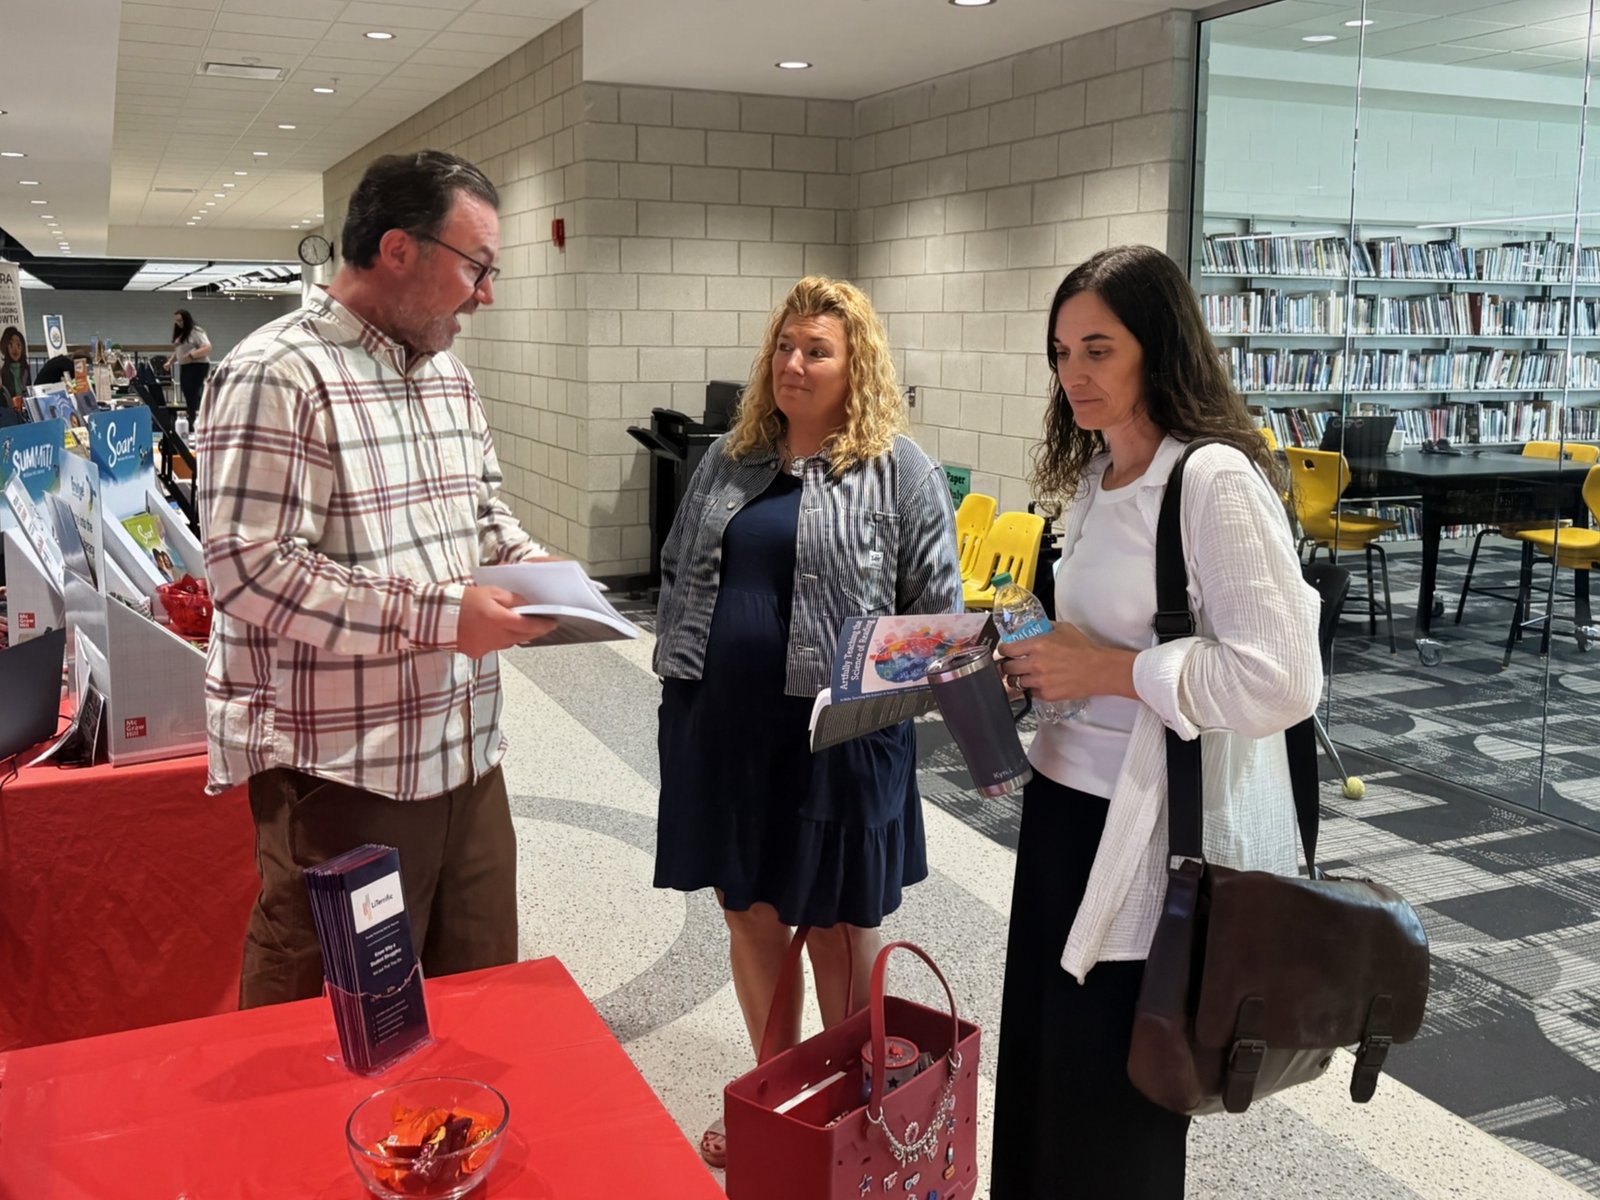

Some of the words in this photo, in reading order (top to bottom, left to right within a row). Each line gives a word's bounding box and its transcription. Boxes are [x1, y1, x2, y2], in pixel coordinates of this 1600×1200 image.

[12, 443, 54, 476] SUMMIT!
[106, 421, 137, 468] Soar!
[946, 471, 966, 486] Paper
[852, 620, 863, 632] the
[844, 630, 861, 660] Teaching
[851, 652, 864, 681] Science
[859, 619, 876, 644] Reading
[840, 660, 853, 691] Artfully
